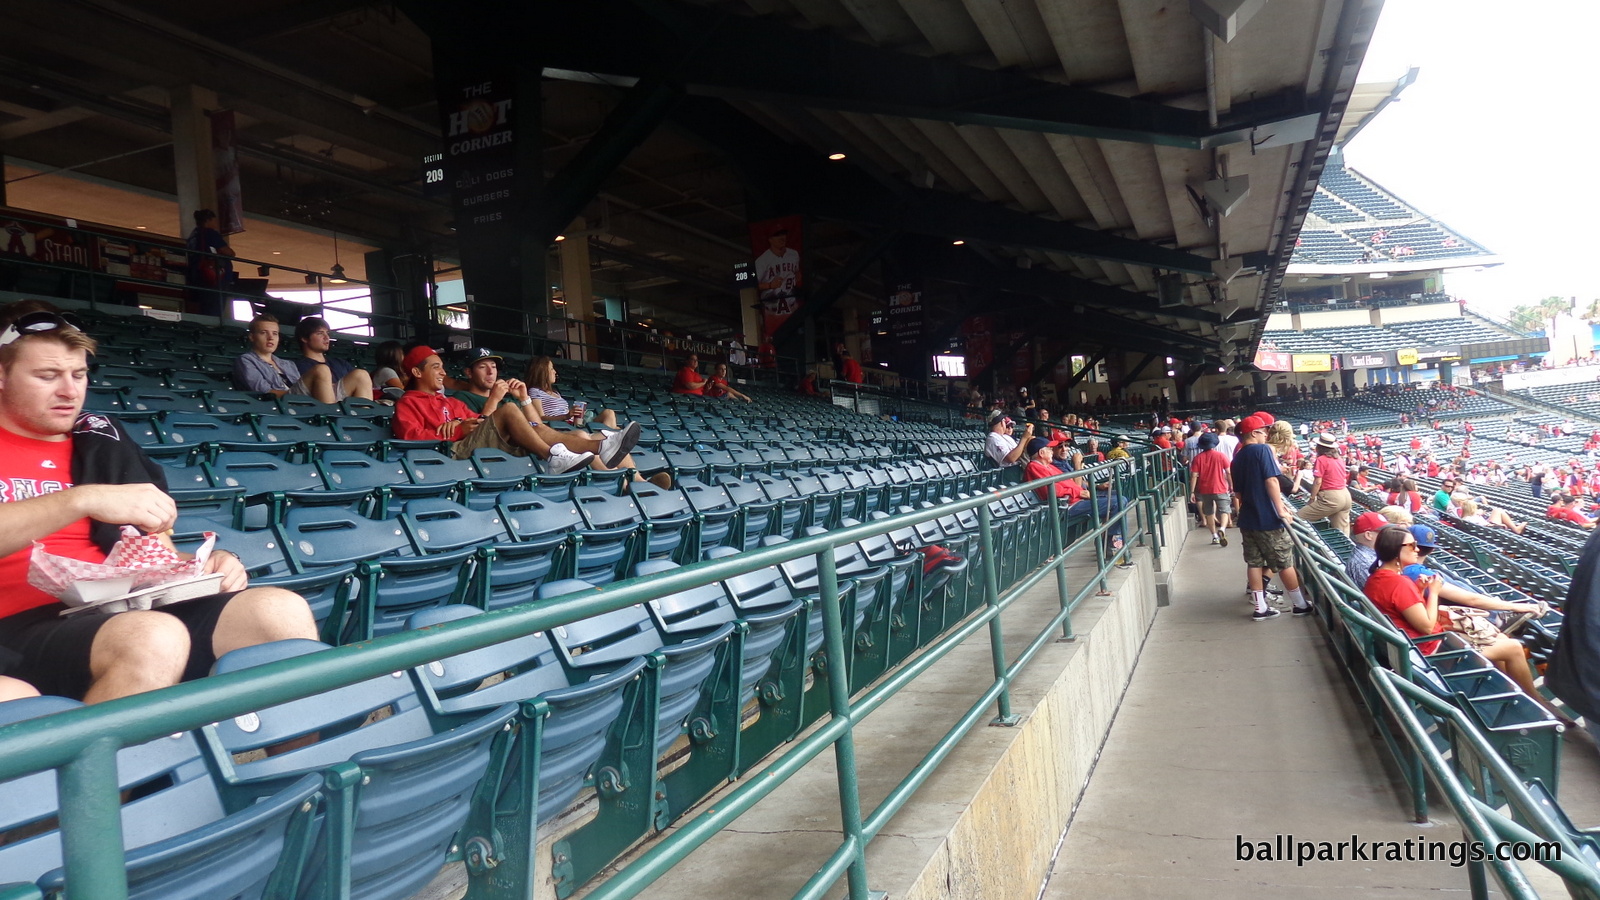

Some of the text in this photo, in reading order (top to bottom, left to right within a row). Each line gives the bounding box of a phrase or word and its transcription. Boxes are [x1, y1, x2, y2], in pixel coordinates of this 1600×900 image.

[462, 81, 493, 99] THE
[448, 99, 512, 137] HOT
[450, 130, 513, 156] CORNER
[426, 168, 444, 184] 209
[485, 168, 514, 182] DOGS
[463, 189, 510, 206] BURGERS
[473, 212, 503, 225] FRIES
[735, 272, 748, 281] 208
[890, 305, 922, 315] CORNER
[453, 342, 468, 352] THE
[1351, 354, 1384, 367] Yard House
